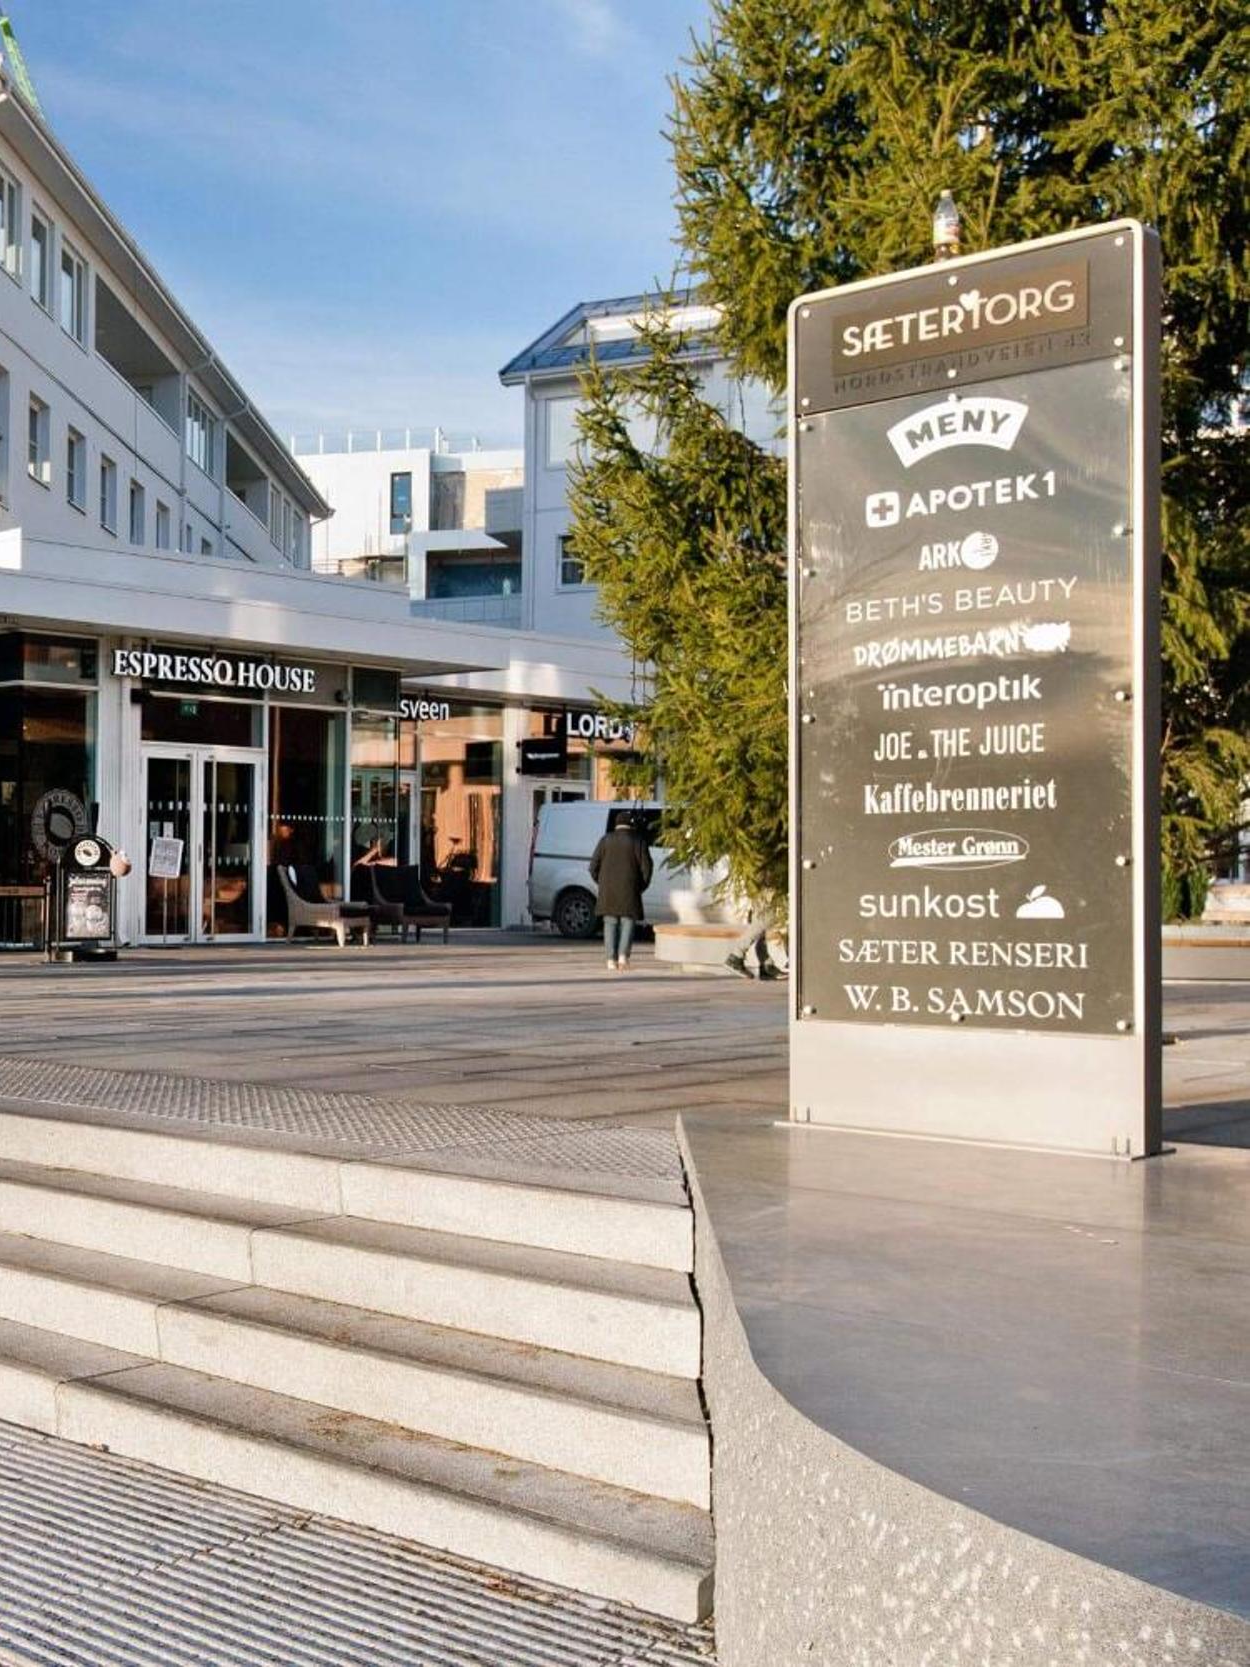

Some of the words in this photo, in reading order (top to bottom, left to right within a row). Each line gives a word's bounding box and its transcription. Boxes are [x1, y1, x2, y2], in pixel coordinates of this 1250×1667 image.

[842, 280, 1075, 357] SÆTERTORG
[905, 409, 1011, 450] MENY
[918, 540, 962, 571] ARK
[846, 592, 943, 624] BETH'S
[955, 576, 1078, 611] BEAUTY
[854, 624, 1021, 668] DRØMMEBARN
[113, 650, 236, 686] ESPRESSO
[237, 661, 316, 693] HOUSE
[400, 699, 449, 721] sveen
[874, 731, 913, 761] JOE
[930, 728, 971, 759] THE
[979, 722, 1045, 756] JUICE
[863, 778, 1058, 814] Kaffebrenneriet
[898, 837, 956, 857] Mester
[858, 886, 1000, 919] sunkost
[838, 938, 940, 966] SÆTER
[949, 941, 1089, 969] RENSERI
[842, 984, 882, 1011] W.
[891, 985, 919, 1012] B.
[927, 987, 1086, 1019] SAMSON
